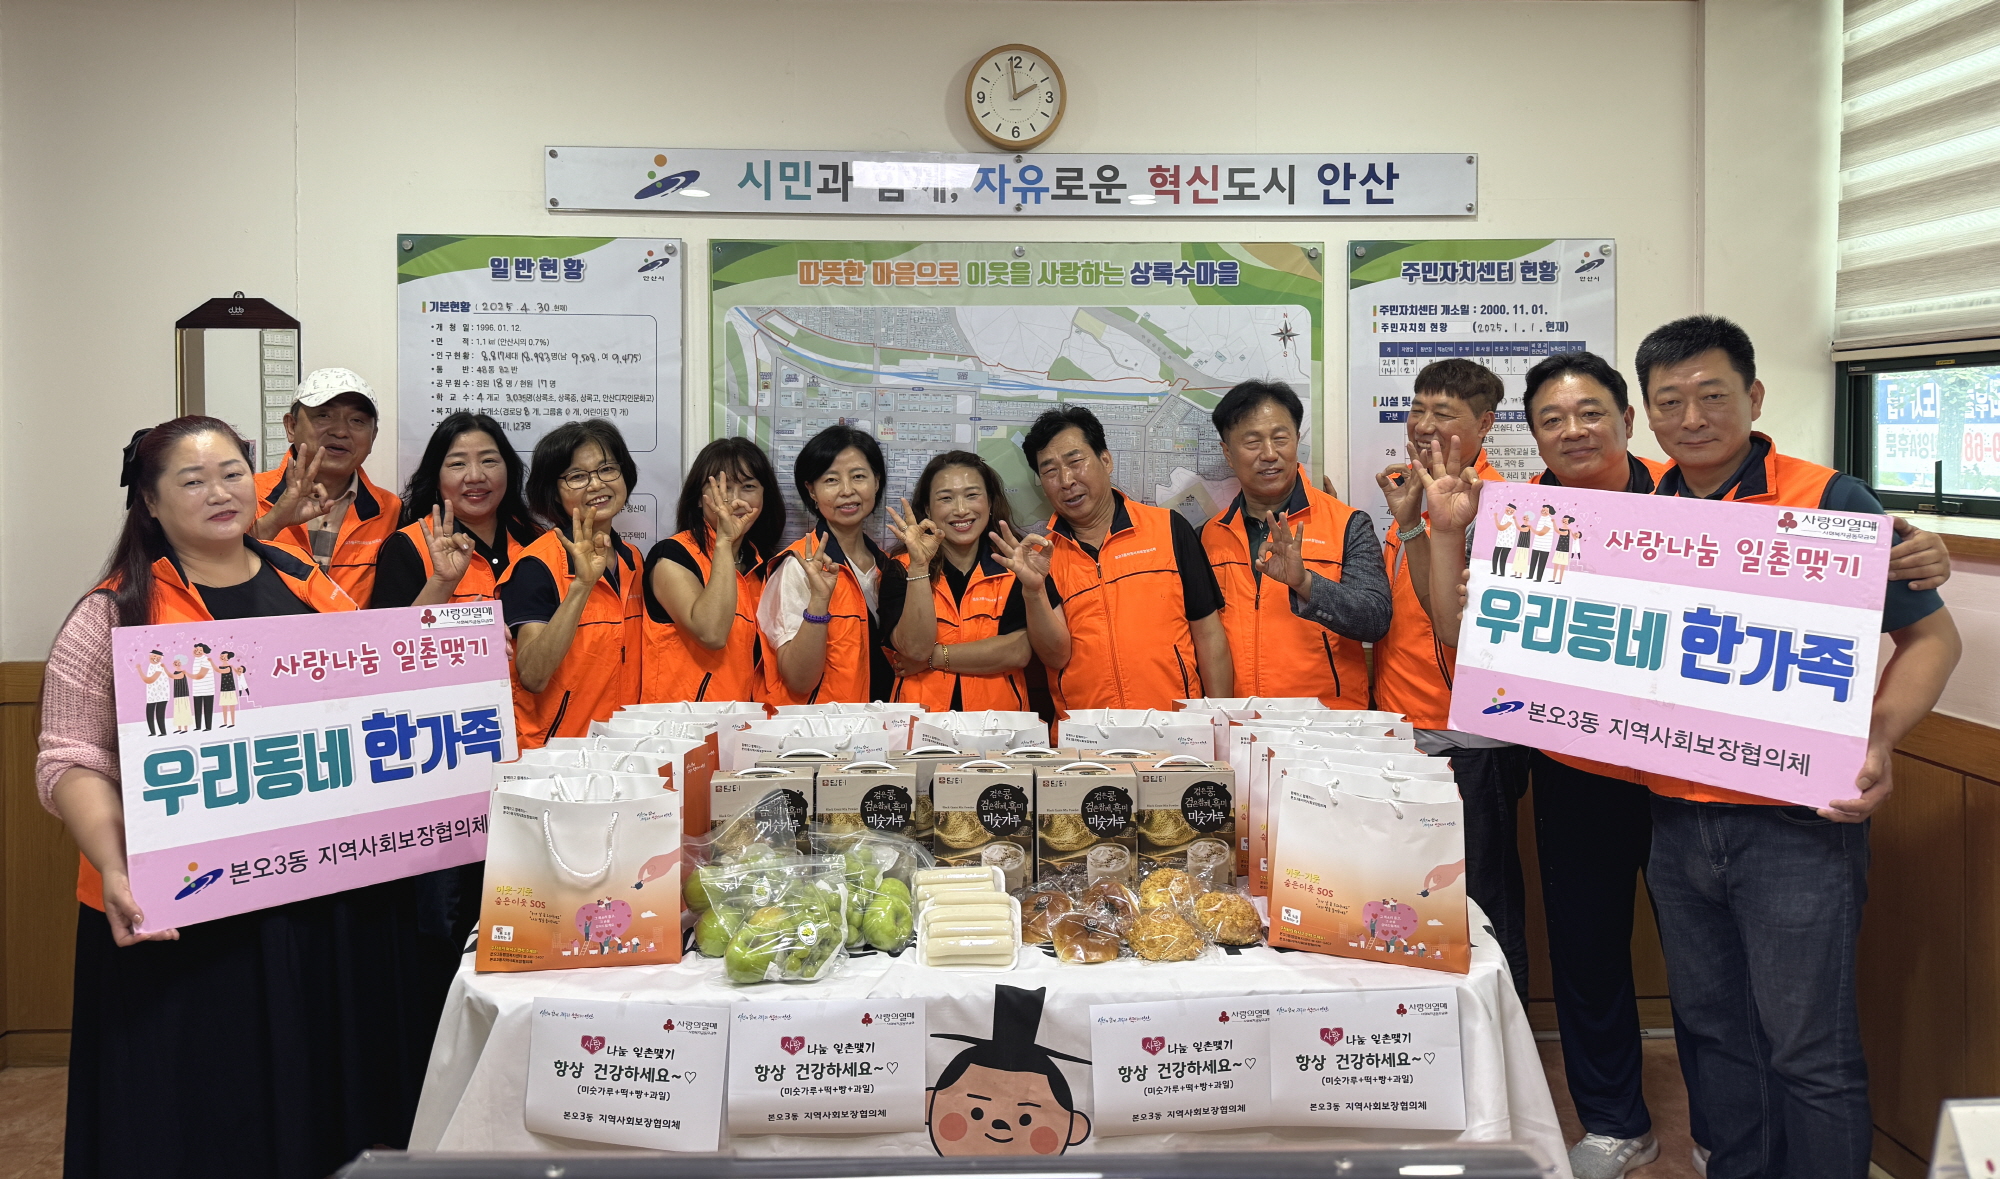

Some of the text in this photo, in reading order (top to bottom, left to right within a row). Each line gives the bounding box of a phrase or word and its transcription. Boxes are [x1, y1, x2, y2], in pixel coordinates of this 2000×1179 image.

[977, 91, 986, 104] 9
[1045, 91, 1054, 104] 3
[1011, 126, 1020, 139] 6
[738, 160, 854, 203] 시민과
[974, 164, 1127, 205] 자유로운
[1148, 164, 1296, 205] 혁신도시
[1317, 162, 1399, 205] 안산
[490, 257, 584, 280] 일반현황
[798, 260, 1240, 287] 따뜻한 마음으로 이웃을 사랑하는 상록수마을
[1401, 261, 1559, 283] 주민자치센터 현황
[429, 301, 471, 313] 기본현황
[1379, 305, 1437, 316] 주민자치센터
[1480, 304, 1510, 316] 2000.
[476, 324, 496, 332] 1996.
[497, 324, 509, 332] 01.
[511, 324, 522, 332] 12.
[1381, 322, 1427, 333] 주민자치회
[1430, 322, 1448, 332] 현황
[1379, 396, 1411, 407] 시설 및
[1385, 413, 1398, 421] 구분
[1802, 514, 1878, 533] 사랑의열매
[1604, 529, 1862, 583] 사랑나눔 일촌맺기
[439, 606, 493, 621] 사랑의열매
[1476, 588, 1855, 703] 우리동네 한가족
[272, 635, 489, 681] 사랑나눔 일촌맺기
[1527, 700, 1811, 777] 본오3동 지역사회보장협의체
[143, 707, 502, 816] 우리동네 한가족
[867, 812, 906, 830] 미숫가루
[983, 812, 1021, 829] 미숫가루
[1088, 813, 1127, 831] 미숫가루
[1187, 809, 1226, 826] 미숫가루
[229, 813, 488, 886] 본오3동 지역사회보장협의체
[1317, 887, 1334, 898] SOS
[530, 899, 546, 909] SOS
[1408, 1002, 1448, 1013] 사랑의열매
[874, 1012, 915, 1022] 사랑의열매
[676, 1020, 718, 1031] 사랑의열매
[1167, 1043, 1188, 1055] 나눔
[1192, 1039, 1233, 1052] 일촌맺기
[1346, 1034, 1367, 1046] 나눔
[1370, 1032, 1412, 1045] 일촌맺기
[606, 1045, 629, 1057] 나눔
[633, 1046, 676, 1060] 일촌맺기
[807, 1044, 829, 1055] 나눔
[833, 1041, 876, 1054] 일촌맺기
[553, 1060, 585, 1079] 항상
[1295, 1053, 1326, 1072] 항상
[754, 1063, 787, 1082] 항상
[1117, 1064, 1149, 1083] 항상
[1321, 1074, 1414, 1086] (미숫가루+떡+빵+과일)
[577, 1085, 671, 1102] (미숫가루+떡+빵+과일)
[780, 1084, 875, 1097] (미숫가루+떡+빵+과일)
[1143, 1080, 1234, 1097] (미숫가루+떡+빵+과일)
[1132, 1104, 1246, 1122] 본오3동 지역사회보장협의체
[1309, 1101, 1427, 1112] 본오3동 지역사회보장협의체
[563, 1111, 681, 1130] 본오3동 지역사회보장협의체
[767, 1109, 887, 1122] 본오3동 지역사회보장협의체
